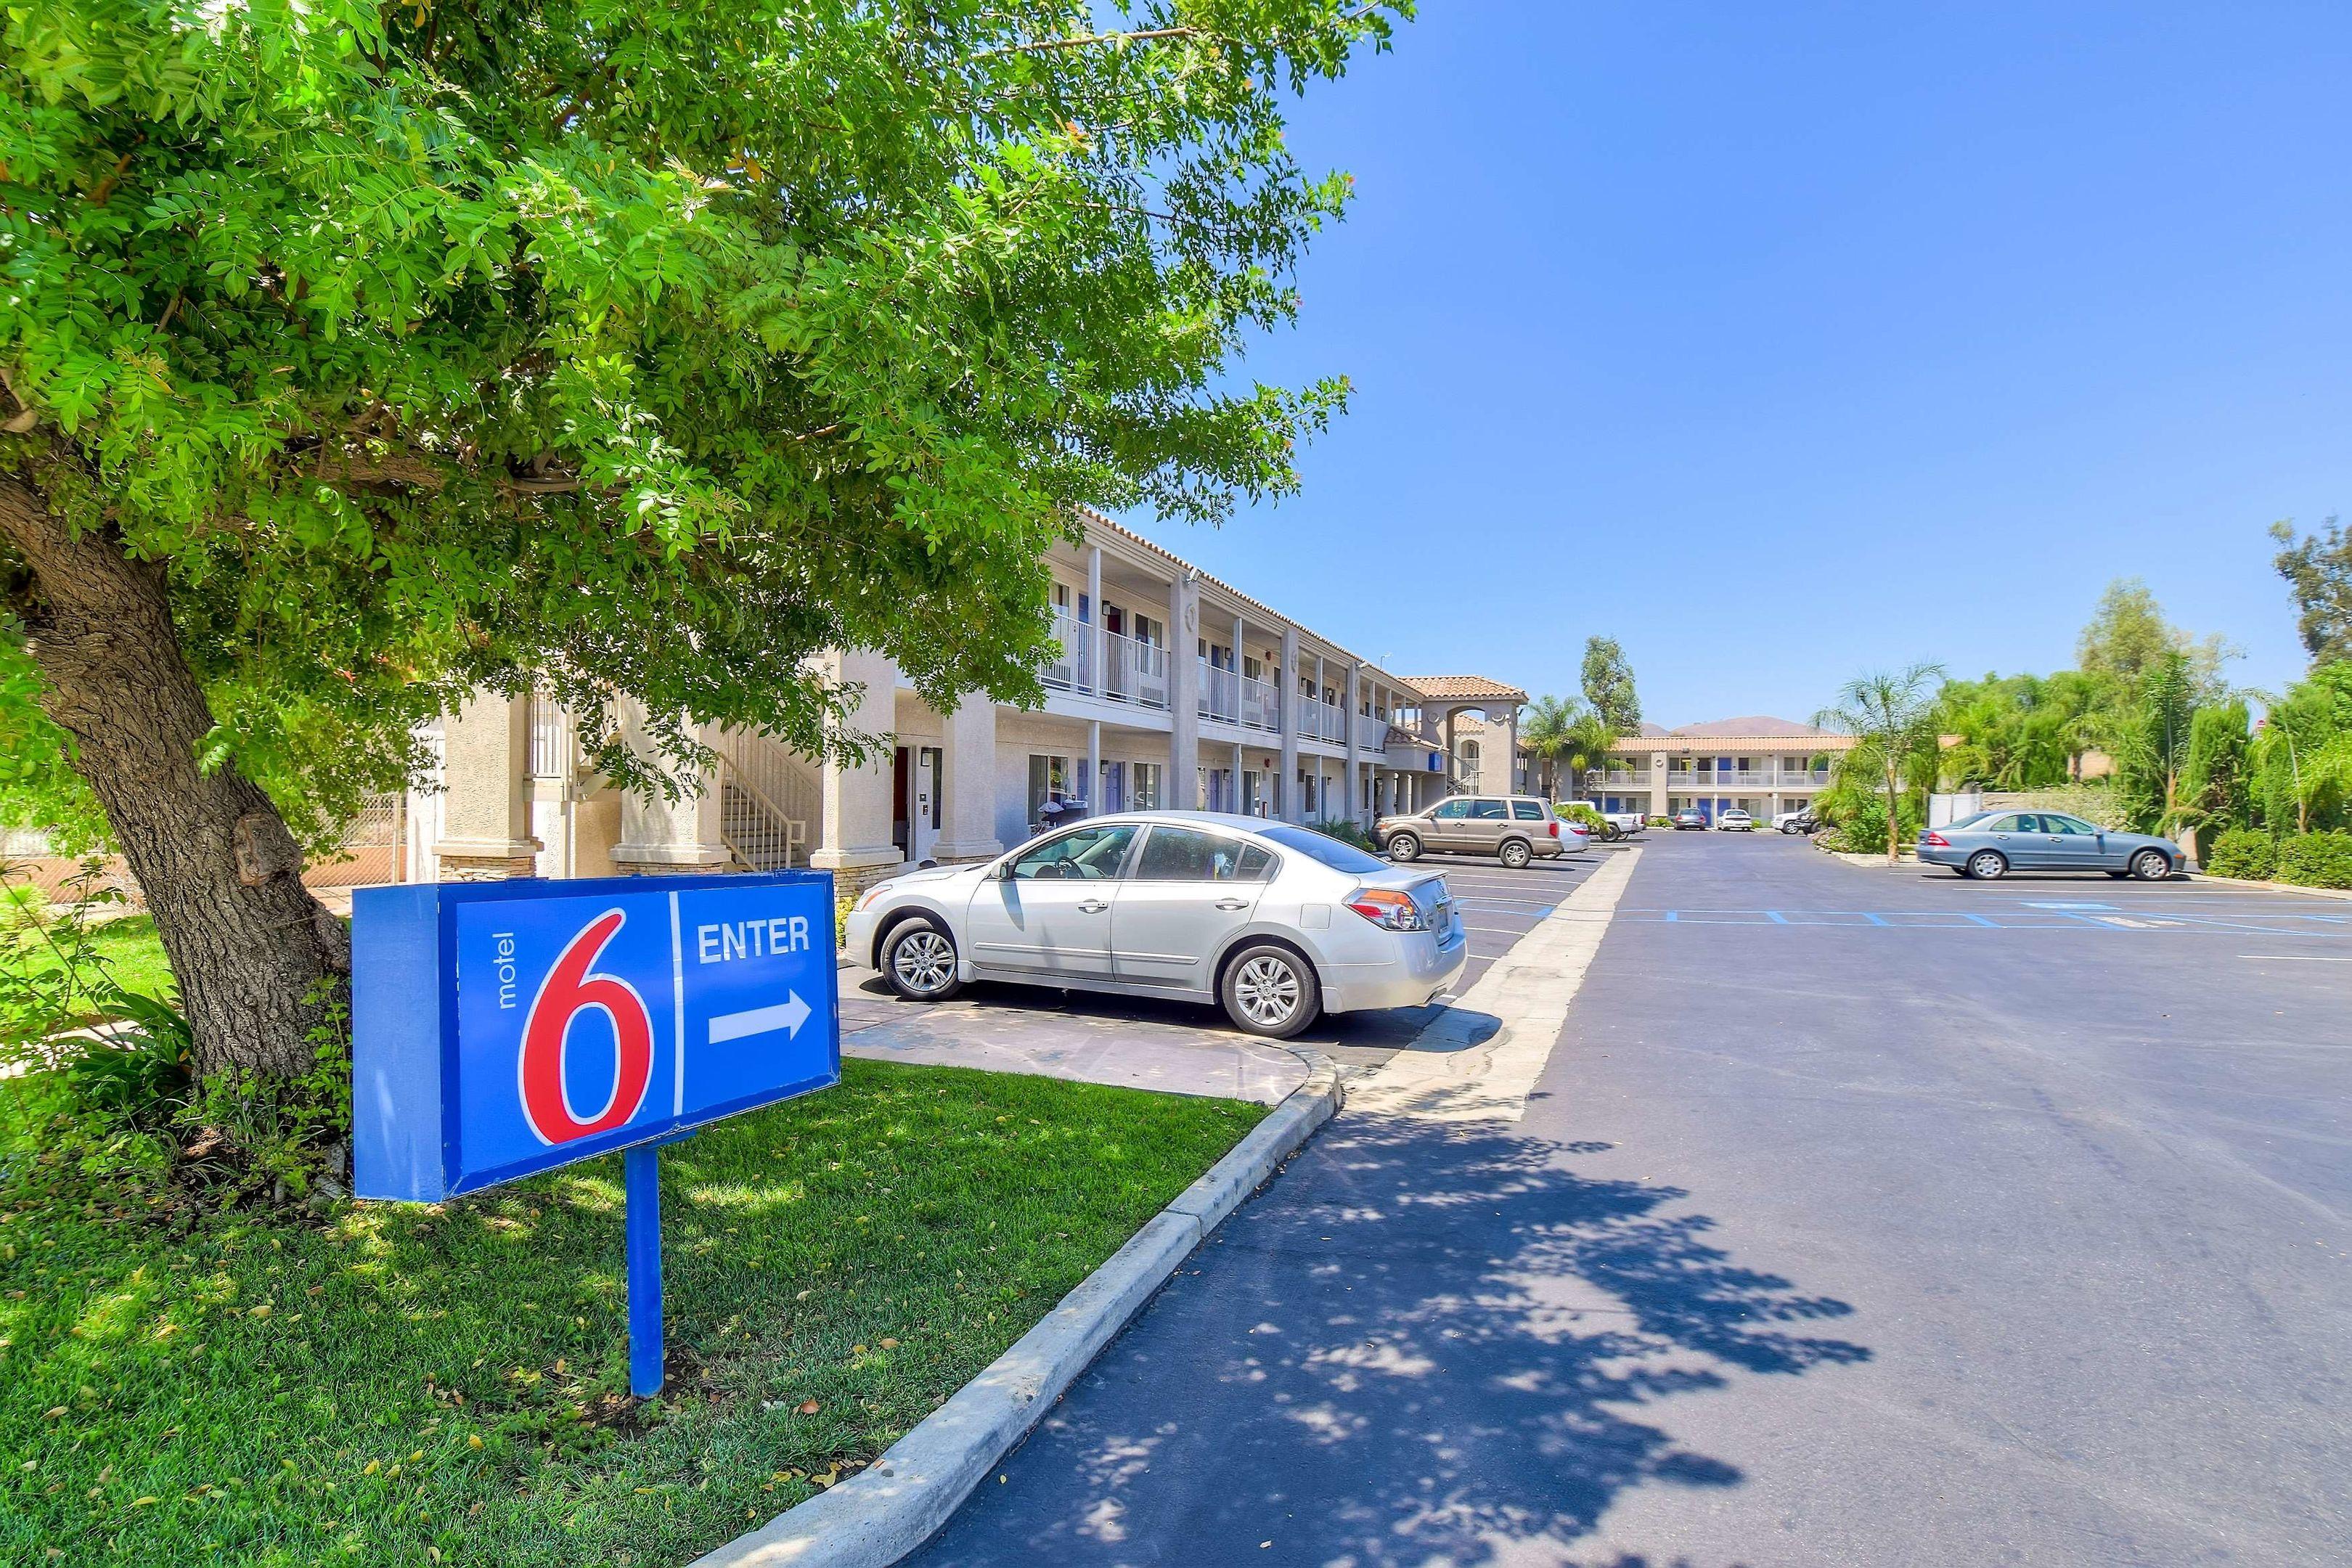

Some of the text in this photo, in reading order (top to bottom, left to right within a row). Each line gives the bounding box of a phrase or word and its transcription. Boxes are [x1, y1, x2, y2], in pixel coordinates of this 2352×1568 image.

[492, 933, 516, 1009] motel
[698, 916, 809, 964] ENTER
[518, 907, 654, 1145] 6
